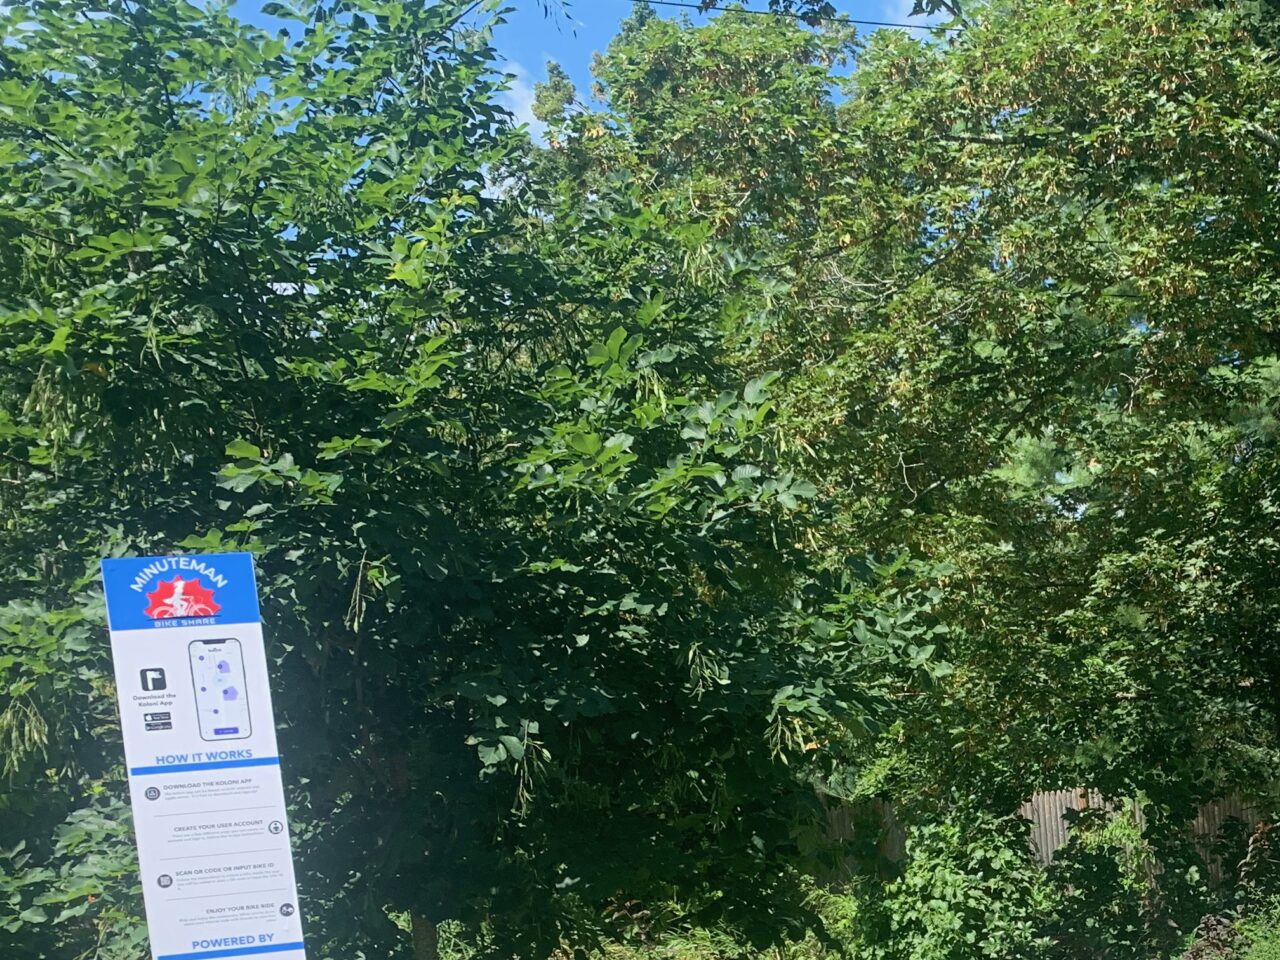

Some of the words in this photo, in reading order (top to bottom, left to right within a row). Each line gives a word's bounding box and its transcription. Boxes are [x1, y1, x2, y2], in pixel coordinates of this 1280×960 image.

[130, 557, 228, 592] MINUTEMAN
[154, 619, 178, 628] BIKE
[181, 618, 216, 626] SHARE
[155, 753, 189, 765] HOW
[192, 752, 203, 762] IT
[205, 749, 253, 761] WORKS
[163, 782, 201, 790] DOWNLOAD
[233, 819, 263, 827] ACCOUNT
[192, 935, 255, 949] POWERED
[259, 933, 275, 943] BY
